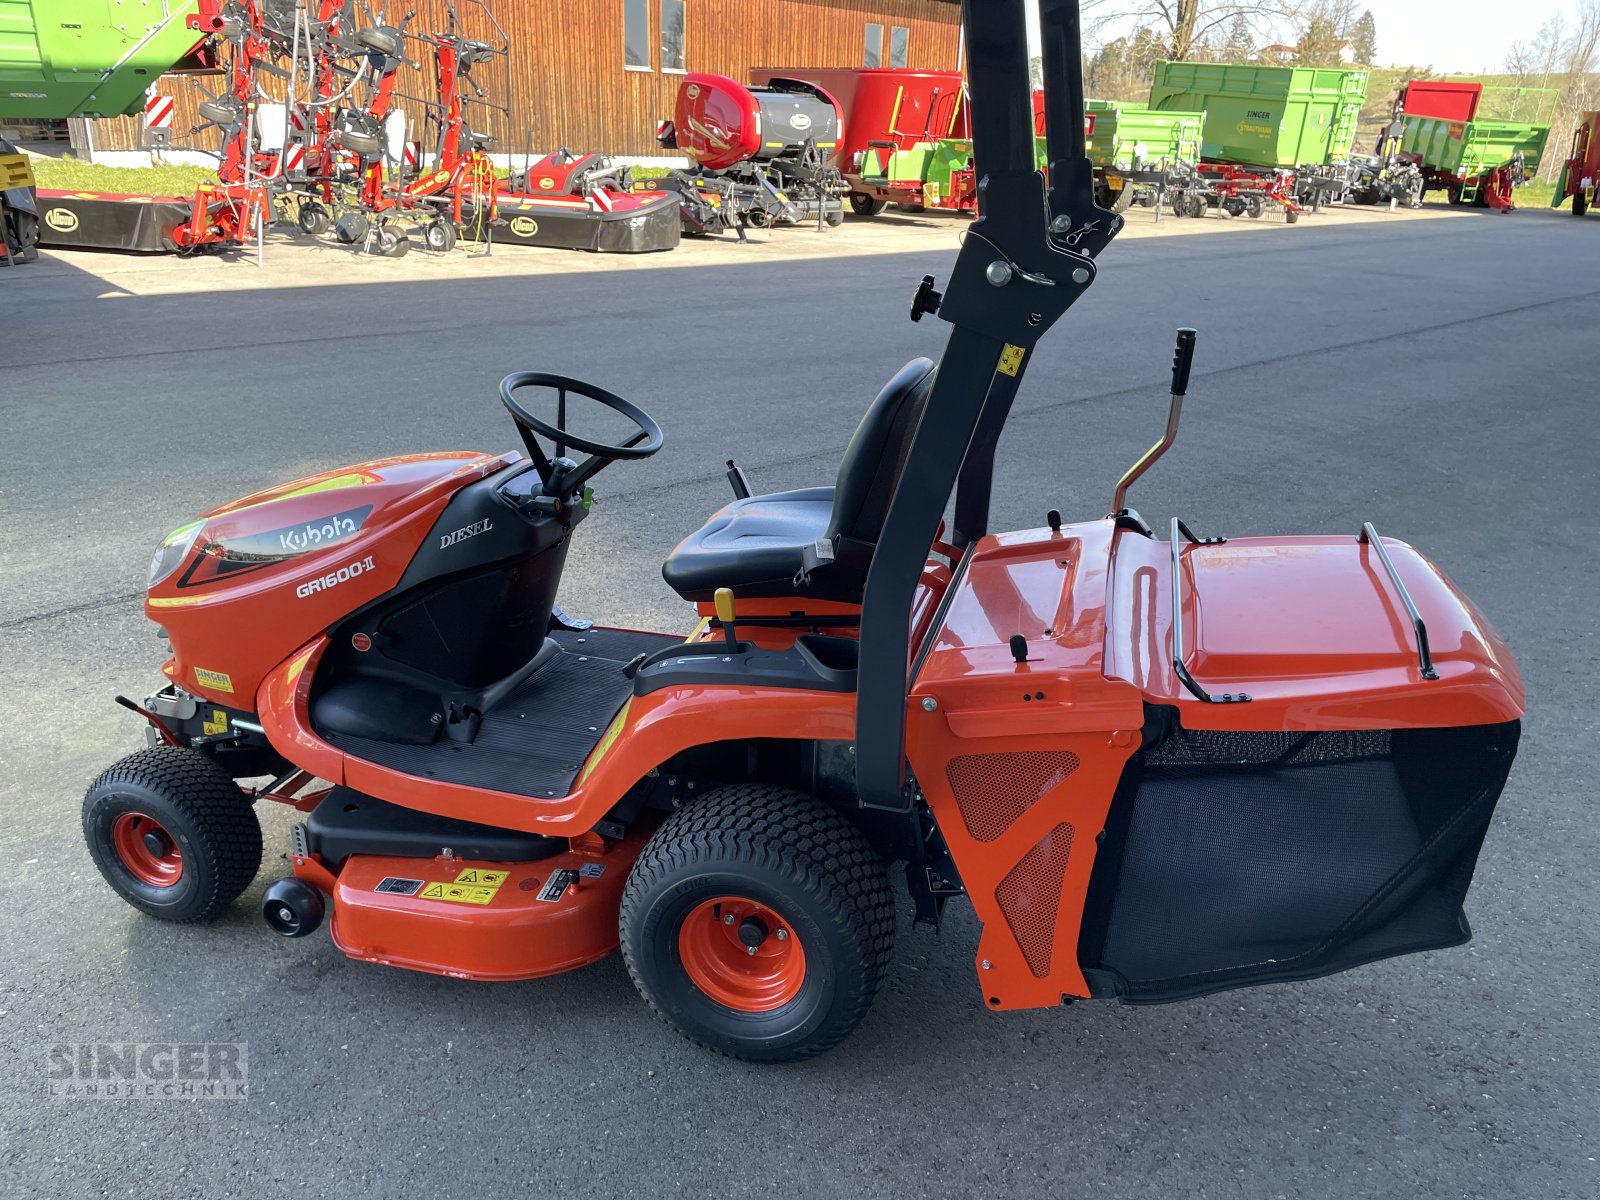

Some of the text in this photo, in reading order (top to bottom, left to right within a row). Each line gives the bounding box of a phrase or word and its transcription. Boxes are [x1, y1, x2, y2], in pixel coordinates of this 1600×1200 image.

[1246, 110, 1271, 119] SINGER
[279, 516, 356, 550] Kubota
[439, 517, 493, 550] DIESEL
[296, 555, 376, 598] GR1600-II
[196, 668, 230, 683] SINGER
